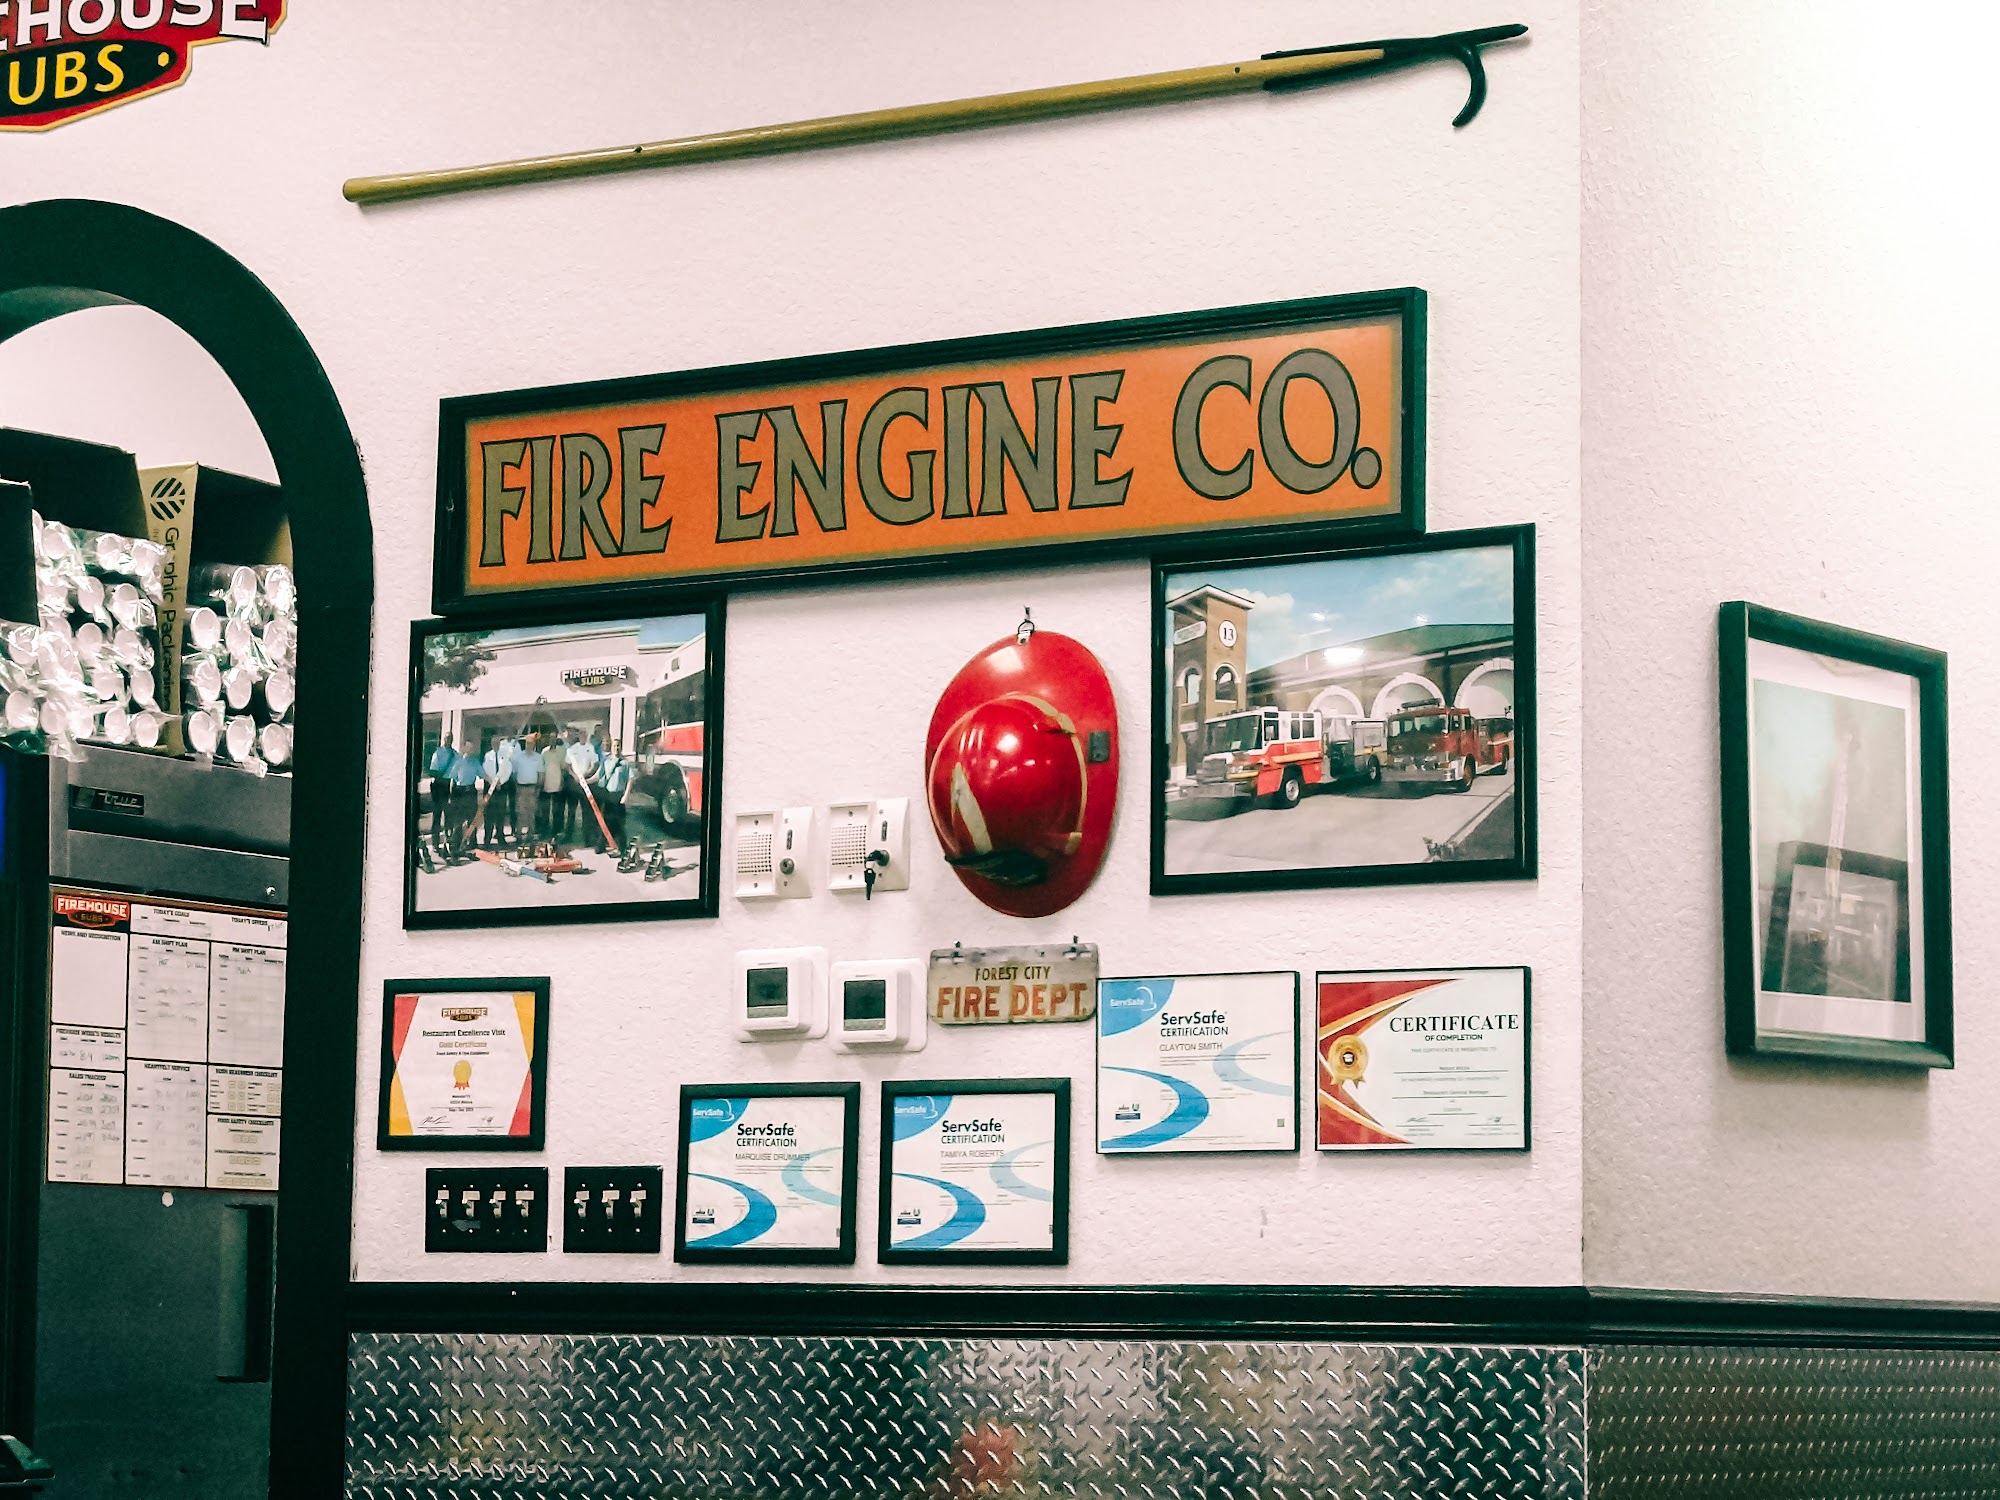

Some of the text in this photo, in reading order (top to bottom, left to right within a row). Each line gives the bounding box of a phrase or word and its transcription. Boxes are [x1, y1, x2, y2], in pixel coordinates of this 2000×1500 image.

[0, 0, 268, 50] HOUSE
[479, 347, 1381, 568] FIRE ENGINE CO.
[1223, 627, 1234, 641] 13
[561, 665, 627, 684] FIREHOUSE
[581, 676, 605, 686] SUBS
[57, 897, 127, 918] FIREHOUSE
[81, 913, 103, 923] SUBS
[975, 966, 1051, 981] FOREST CITY
[937, 985, 1000, 1018] FIRE
[442, 1008, 487, 1018] FIREHOUSE
[1161, 1010, 1225, 1025] ServSafe
[1389, 1014, 1519, 1032] CERTIFICATE
[457, 1029, 490, 1037] Excellence
[1160, 1026, 1229, 1037] CERTIFICATION
[1436, 1033, 1483, 1041] COMPLETION
[1159, 1042, 1223, 1052] CLAYTON SMITH
[737, 1122, 795, 1136] ServSafe
[942, 1117, 1002, 1132] ServSafe
[736, 1138, 797, 1147] CERTIFICATION
[941, 1134, 1005, 1144] CERTIFICATION
[735, 1153, 772, 1161] MARQUISE
[969, 1149, 1004, 1157] ROBERTS
